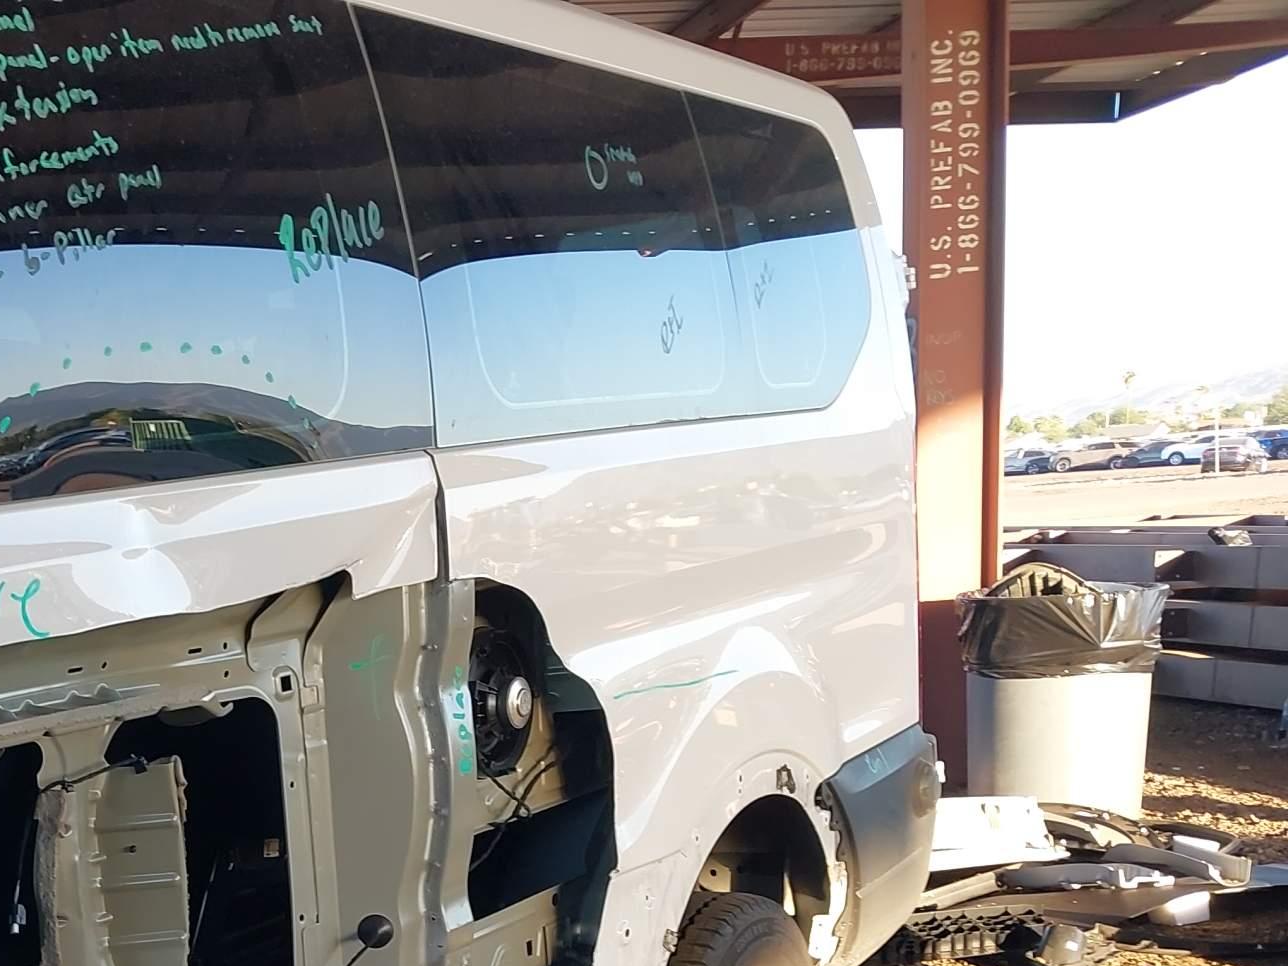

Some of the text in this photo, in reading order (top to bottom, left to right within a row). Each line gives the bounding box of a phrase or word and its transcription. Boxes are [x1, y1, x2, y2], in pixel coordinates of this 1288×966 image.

[930, 29, 953, 84] INC.
[930, 100, 953, 210] PREFAB
[956, 29, 981, 275] 1-866-799-0969
